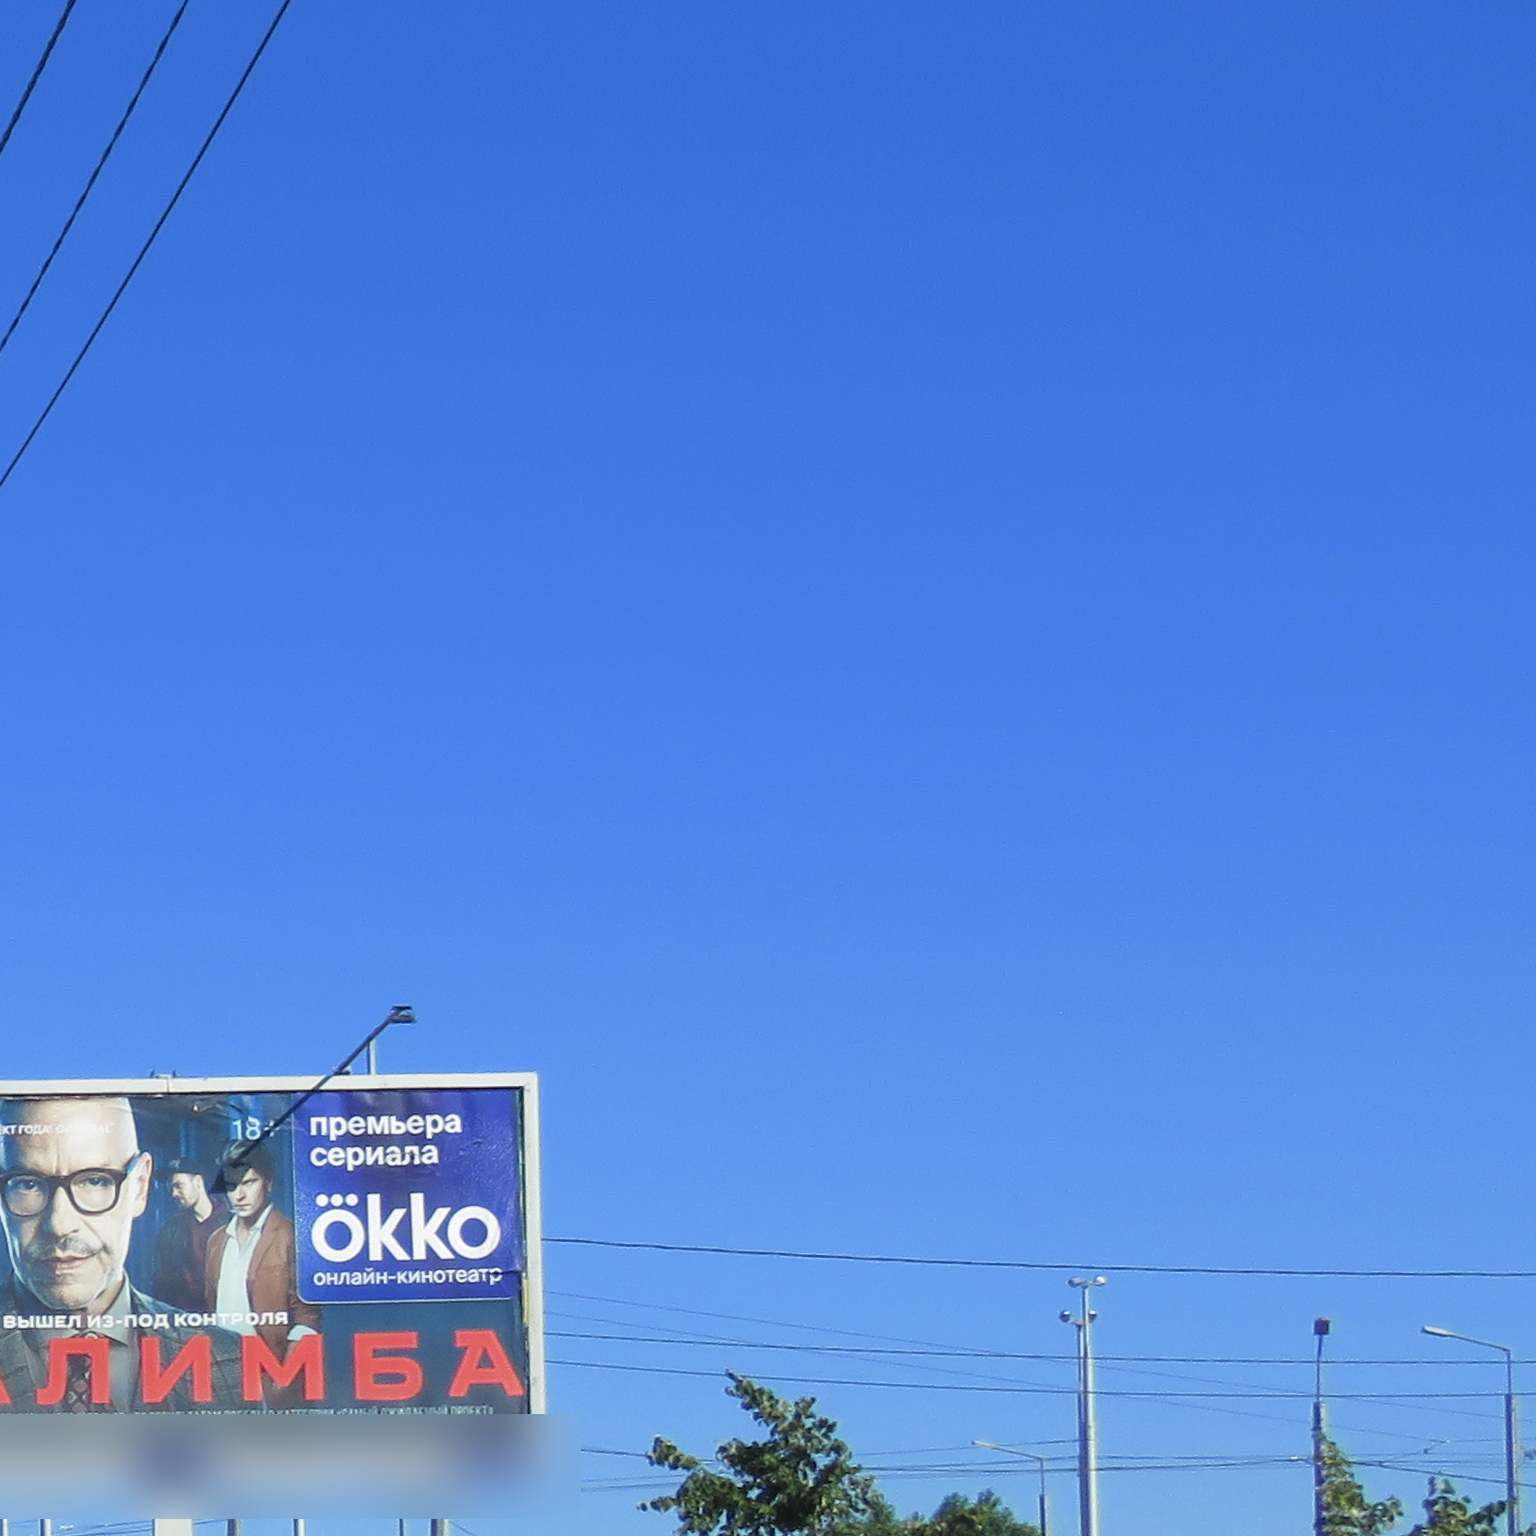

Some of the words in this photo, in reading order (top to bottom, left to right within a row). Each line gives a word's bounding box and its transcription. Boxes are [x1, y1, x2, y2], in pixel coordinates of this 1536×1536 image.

[310, 1113, 463, 1141] премьера
[310, 1143, 440, 1171] сериала
[313, 1267, 504, 1286] онлайн-кинотеатр
[2, 1314, 81, 1329] ВЫШЕЛ
[87, 1313, 170, 1329] ИЗ-ПОД
[174, 1311, 289, 1327] КОНТРОЛЯ
